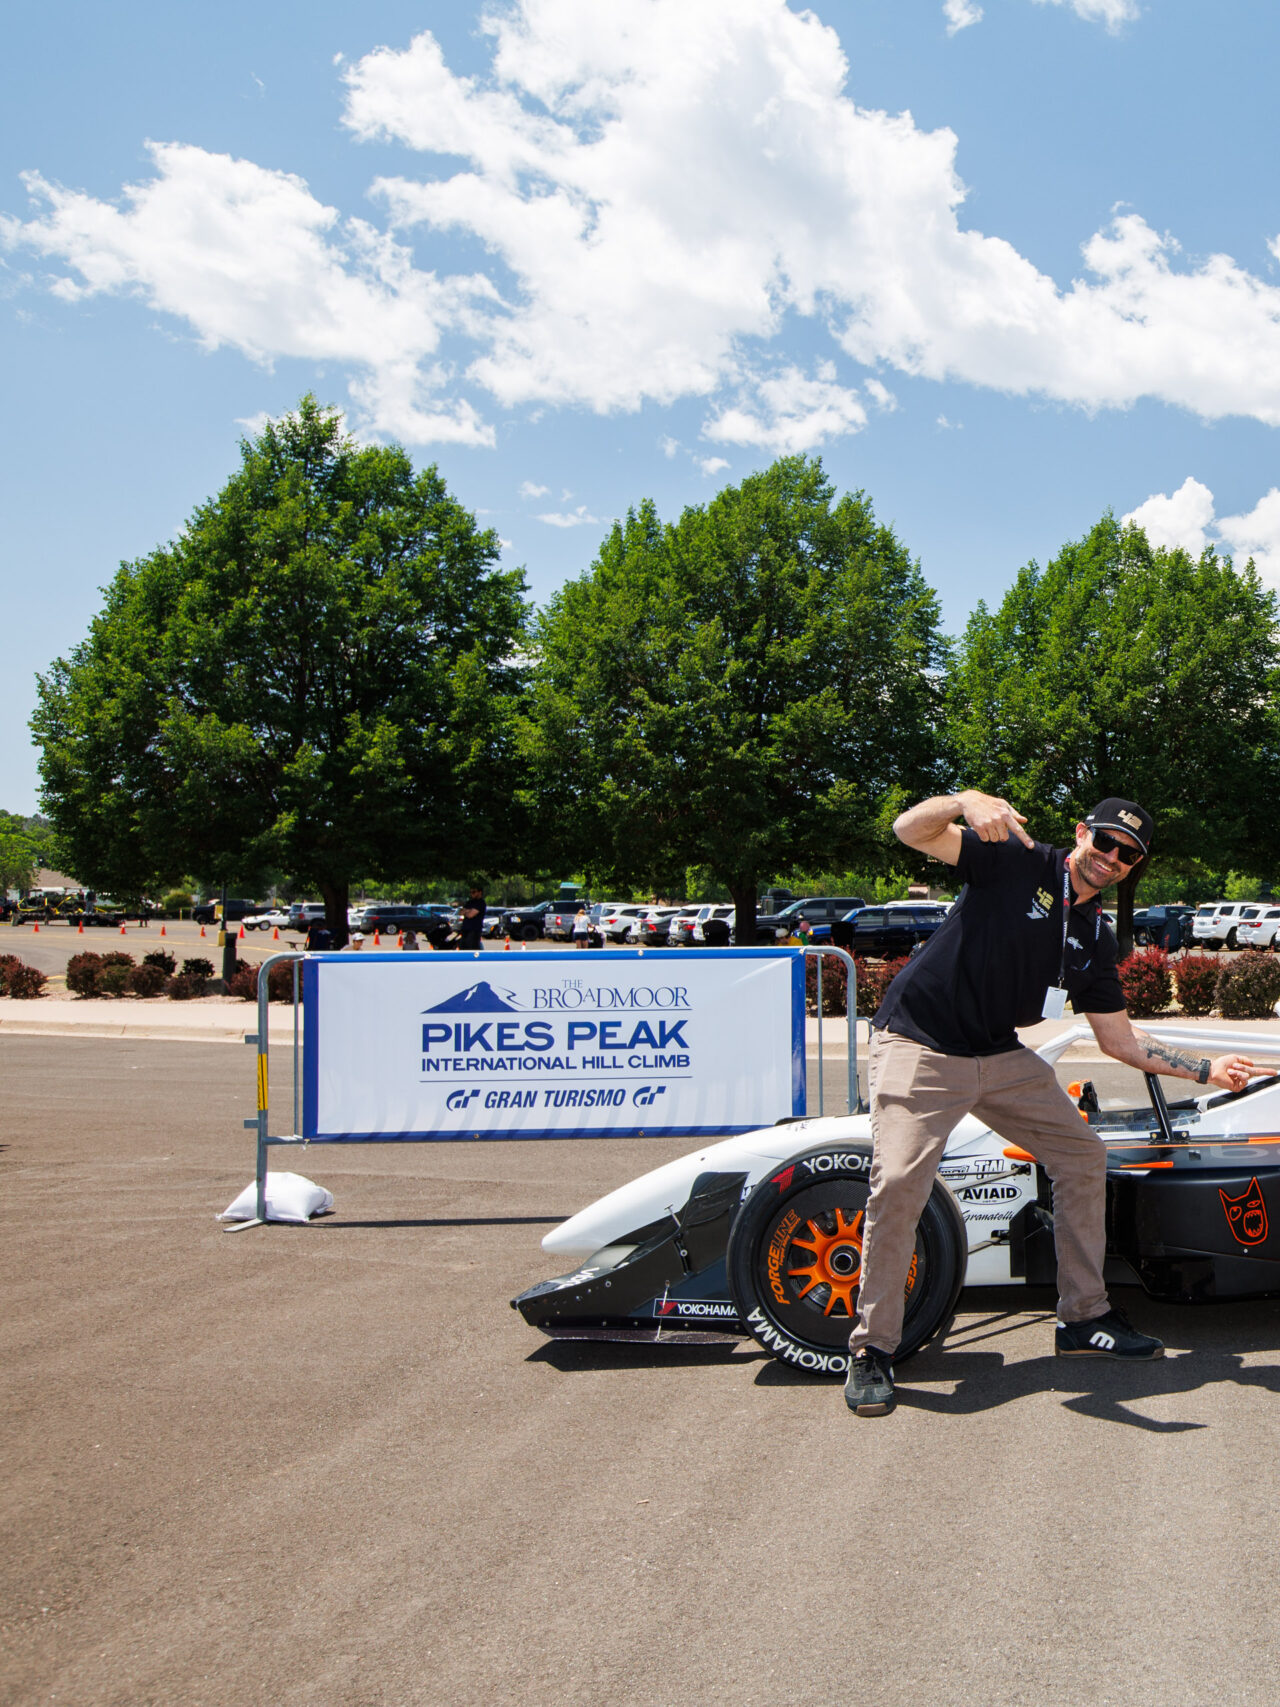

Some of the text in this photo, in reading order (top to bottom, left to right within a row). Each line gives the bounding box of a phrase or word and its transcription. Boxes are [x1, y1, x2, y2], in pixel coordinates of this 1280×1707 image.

[1117, 809, 1143, 831] 42
[1036, 887, 1054, 910] 42
[563, 979, 583, 988] THE
[533, 986, 690, 1008] BROADMOOR
[422, 1020, 690, 1052] PIKES PEAK
[422, 1054, 690, 1071] INTERNATIONAL HILL CLIMB
[484, 1090, 538, 1108] GRAN
[544, 1088, 627, 1107] TURISMO
[803, 1153, 873, 1175] YOKOH
[962, 1187, 1018, 1200] AVIAID
[767, 1208, 800, 1305] FORGELINE
[677, 1303, 738, 1317] YOKOHAMA
